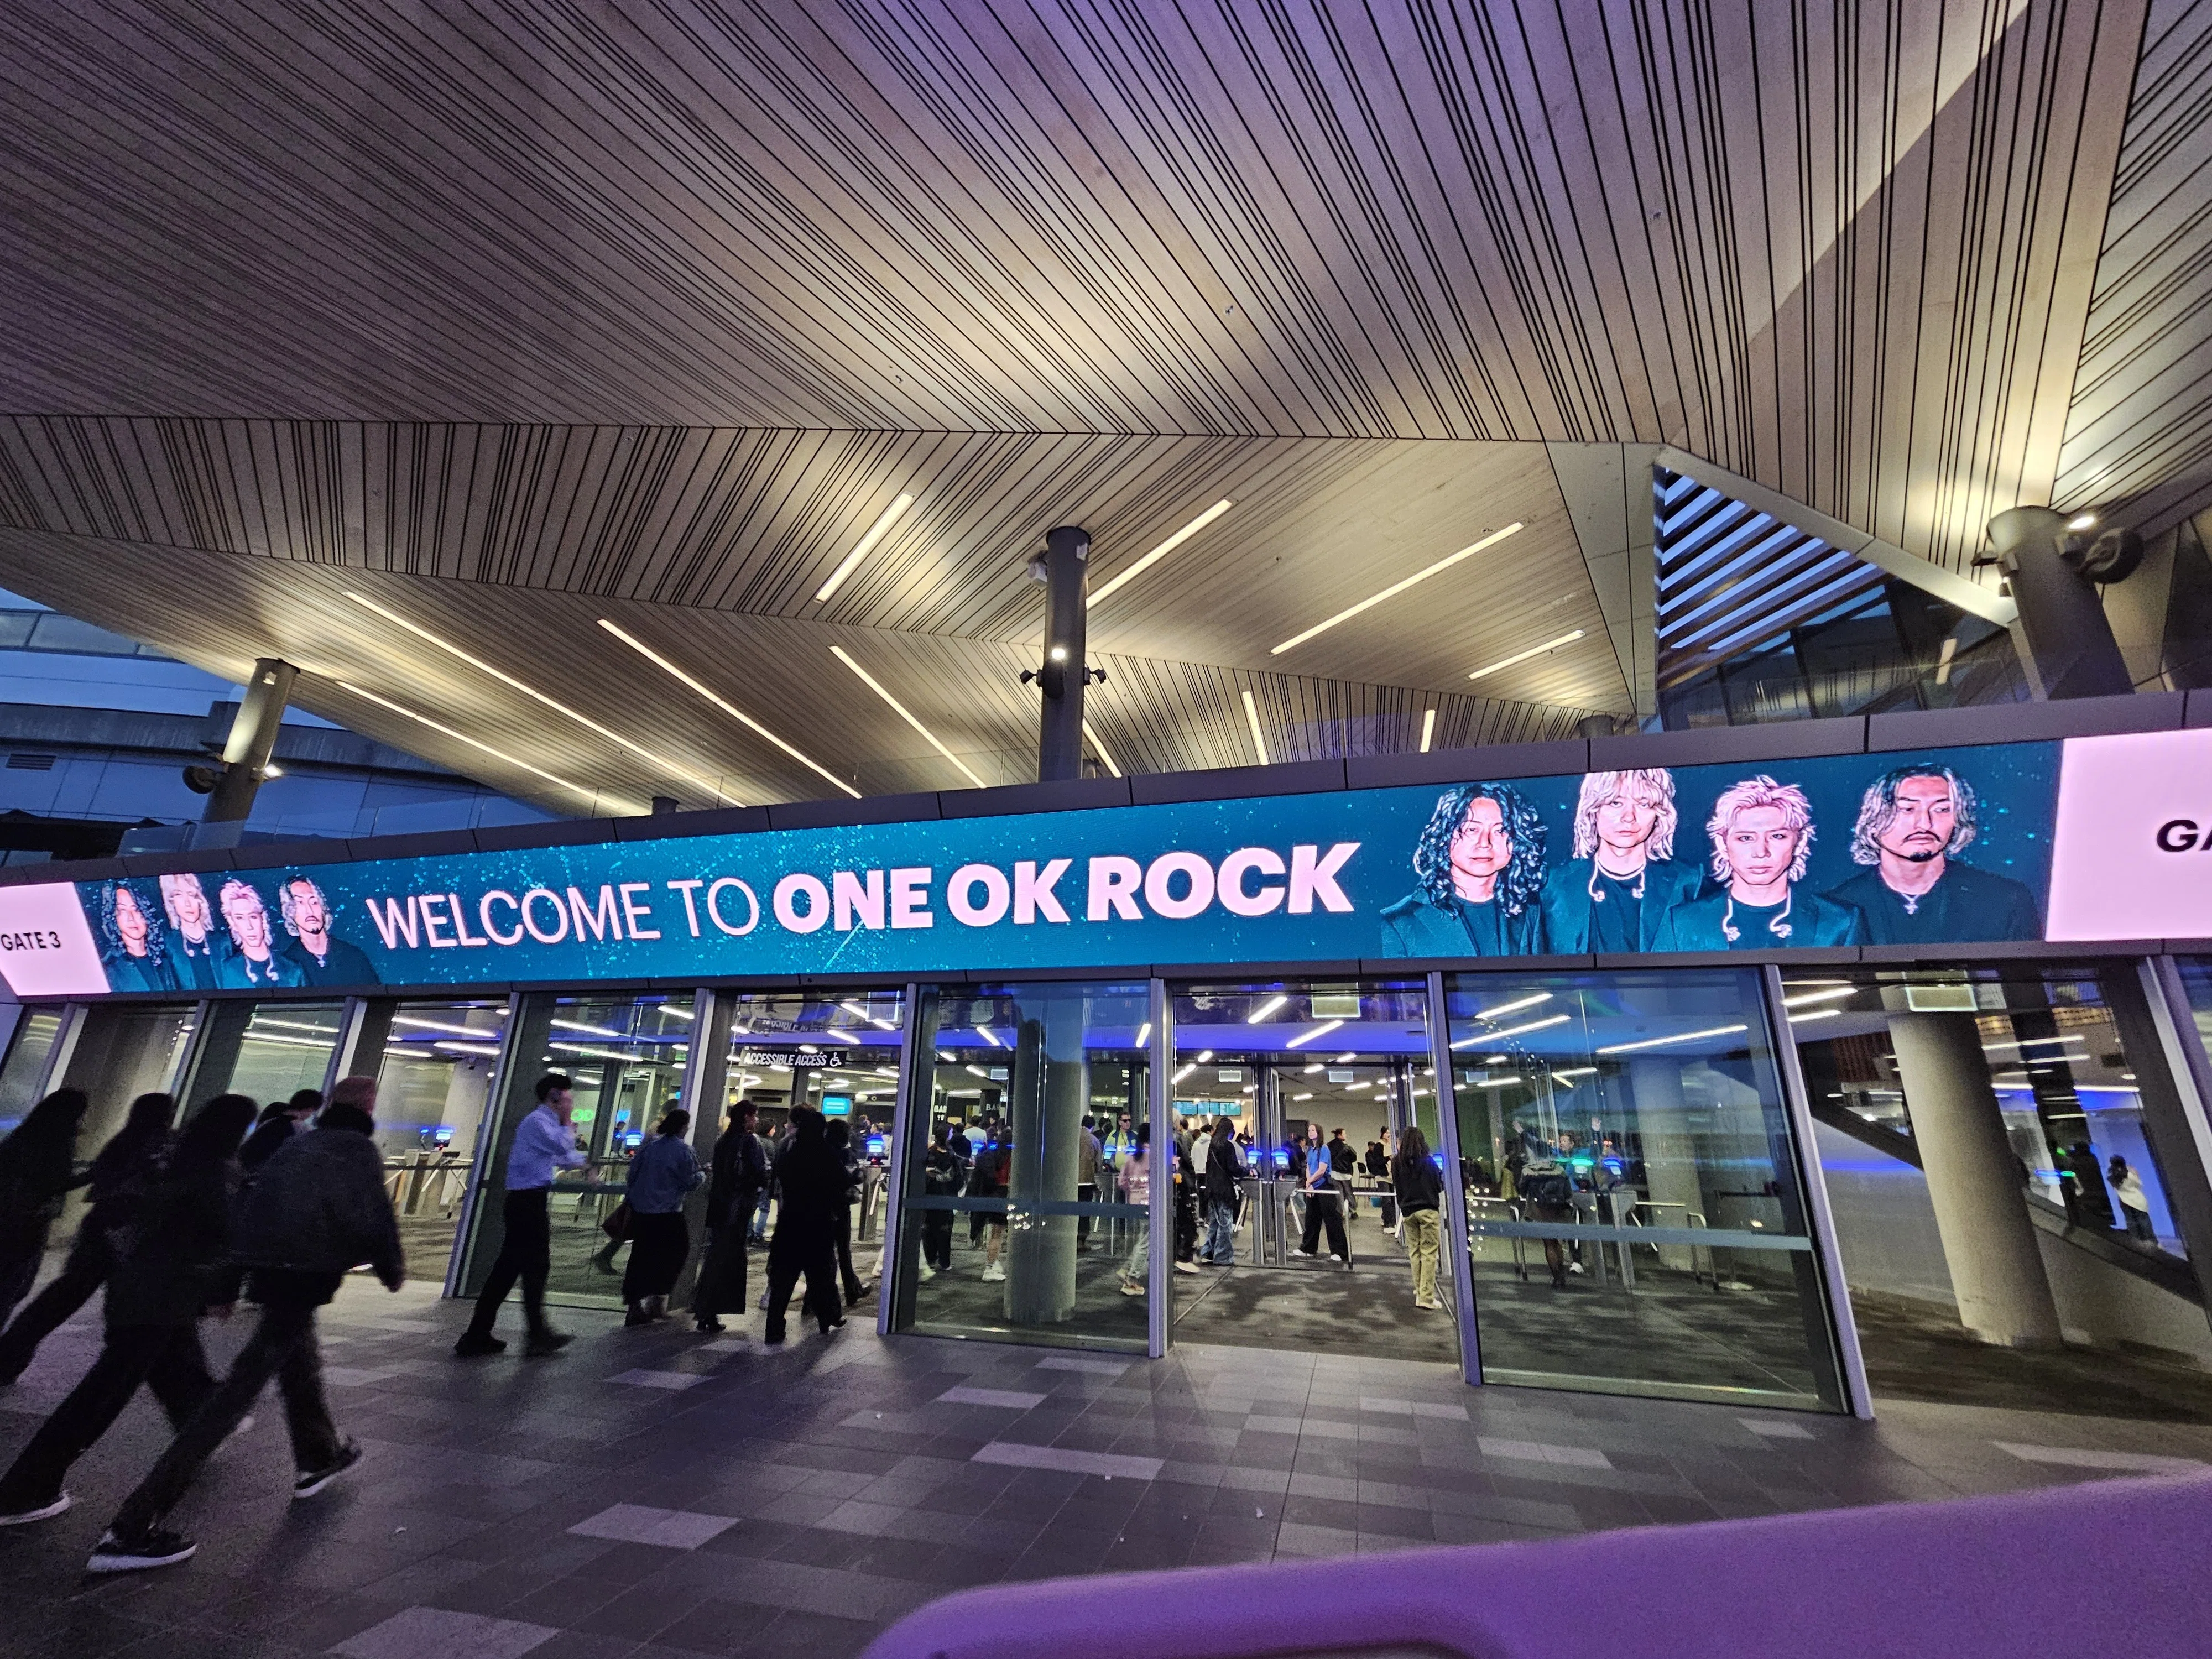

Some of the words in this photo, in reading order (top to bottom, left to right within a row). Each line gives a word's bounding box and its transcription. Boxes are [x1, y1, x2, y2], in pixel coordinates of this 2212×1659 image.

[365, 883, 661, 950] WELCOME
[667, 877, 760, 937] TO
[774, 867, 933, 933] ONE
[947, 859, 1073, 927] OK
[1087, 842, 1361, 922] ROCK
[1, 932, 48, 951] GATE
[49, 931, 61, 948] 3
[743, 1052, 795, 1066] ACCESSIBLE
[794, 1053, 827, 1066] ACCESS
